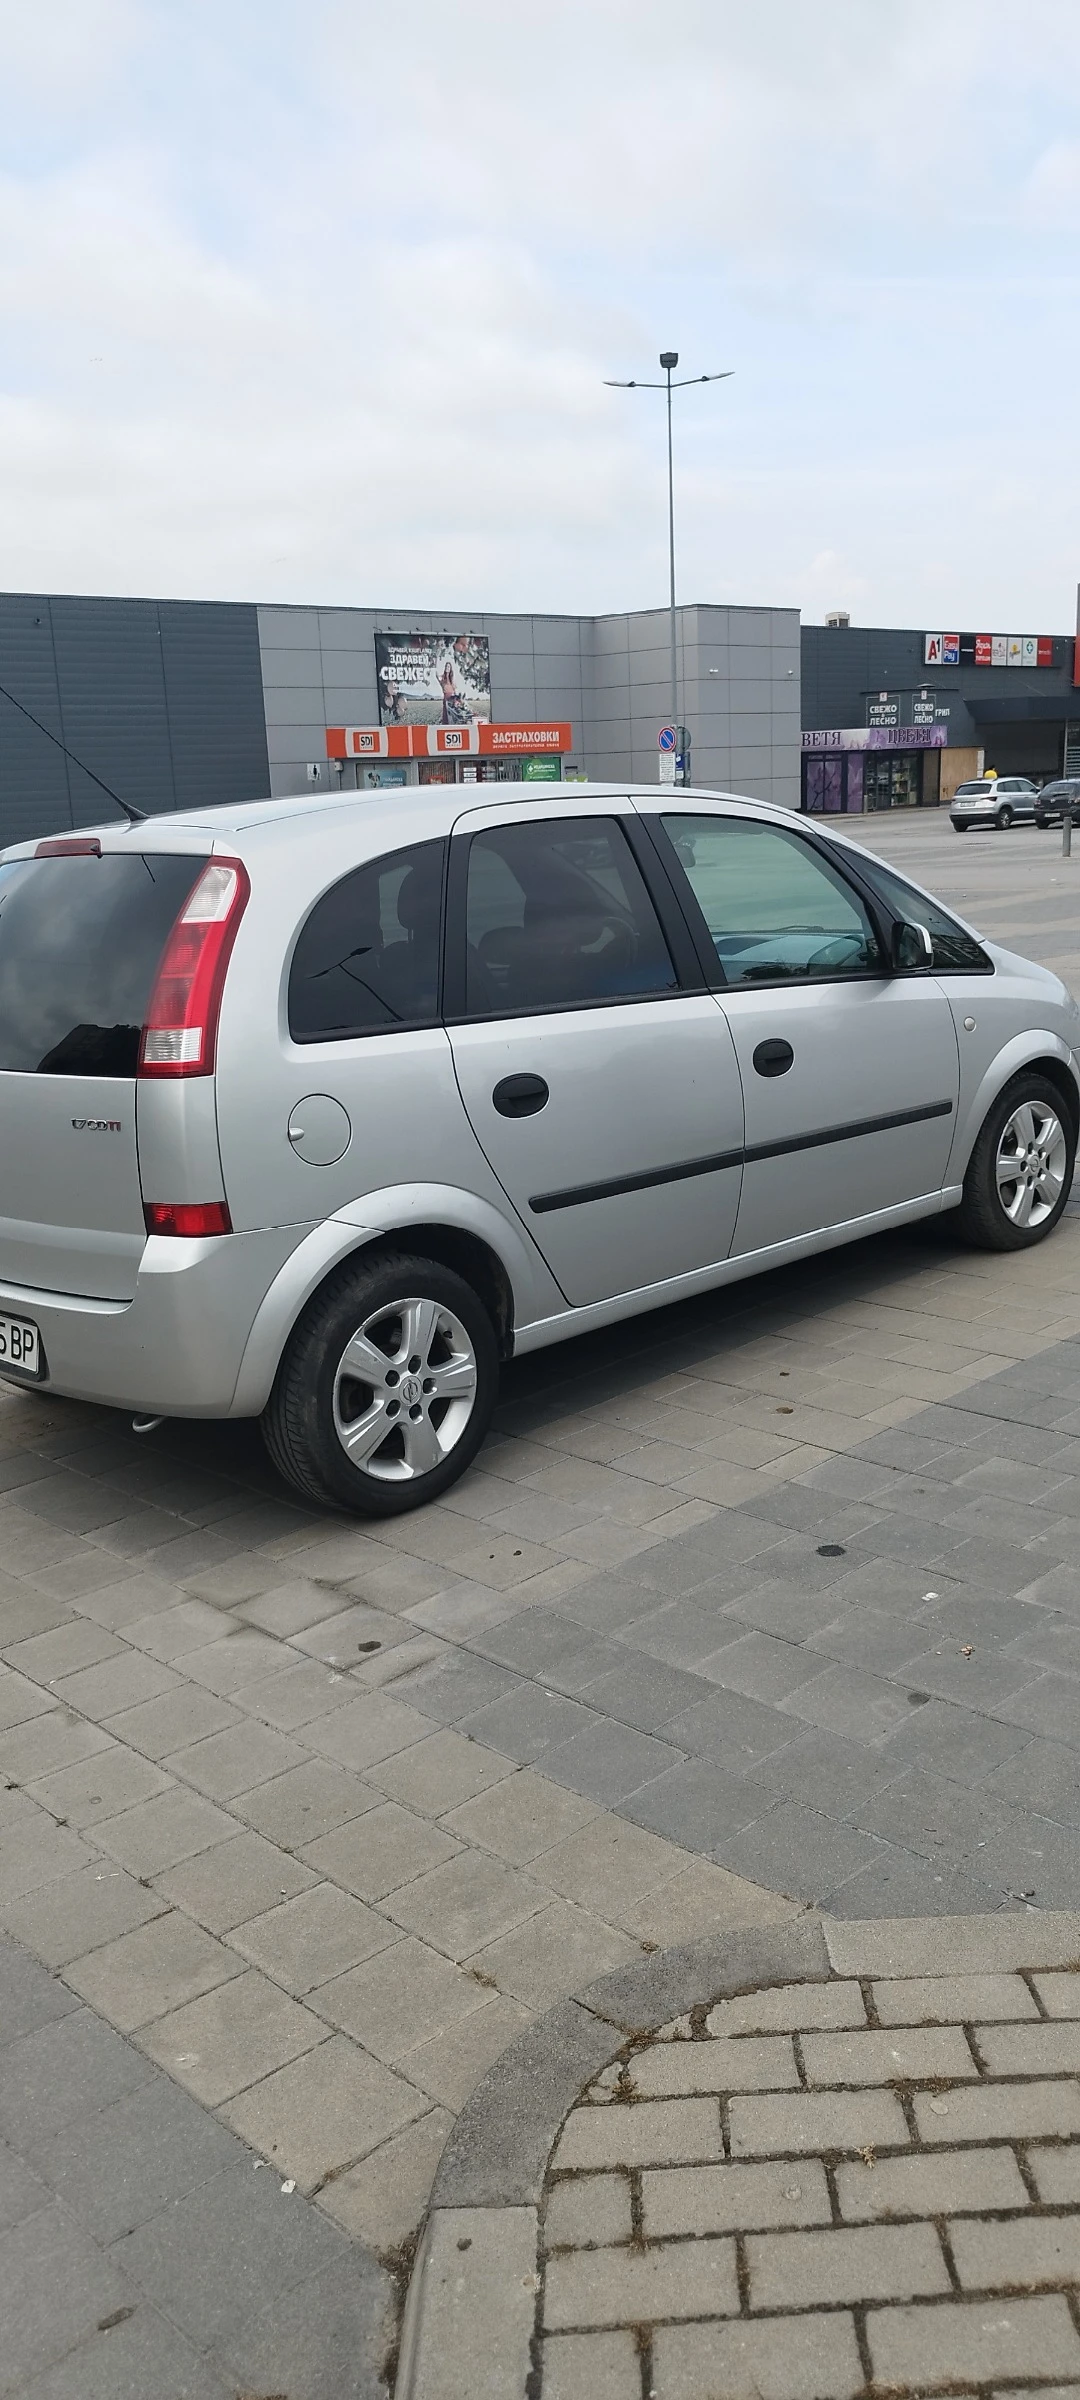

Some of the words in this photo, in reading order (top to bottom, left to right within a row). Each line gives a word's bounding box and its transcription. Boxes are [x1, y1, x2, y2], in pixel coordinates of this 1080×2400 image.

[928, 638, 940, 660] A1
[869, 704, 897, 714] СВЕЖО
[914, 703, 934, 712] СВЕЖО
[935, 708, 950, 717] ГРИЛ
[869, 716, 897, 726] ЛЕСНО
[914, 715, 934, 724] ЛЕСНО
[360, 736, 373, 746] SDI
[446, 734, 461, 744] SDI
[492, 731, 560, 744] ЗАСТРАХОВКИ
[801, 732, 841, 747] ВЕТЯ
[887, 728, 932, 745] ЦВЕТЯ
[87, 1119, 121, 1132] CDTI
[11, 1325, 34, 1363] BP
